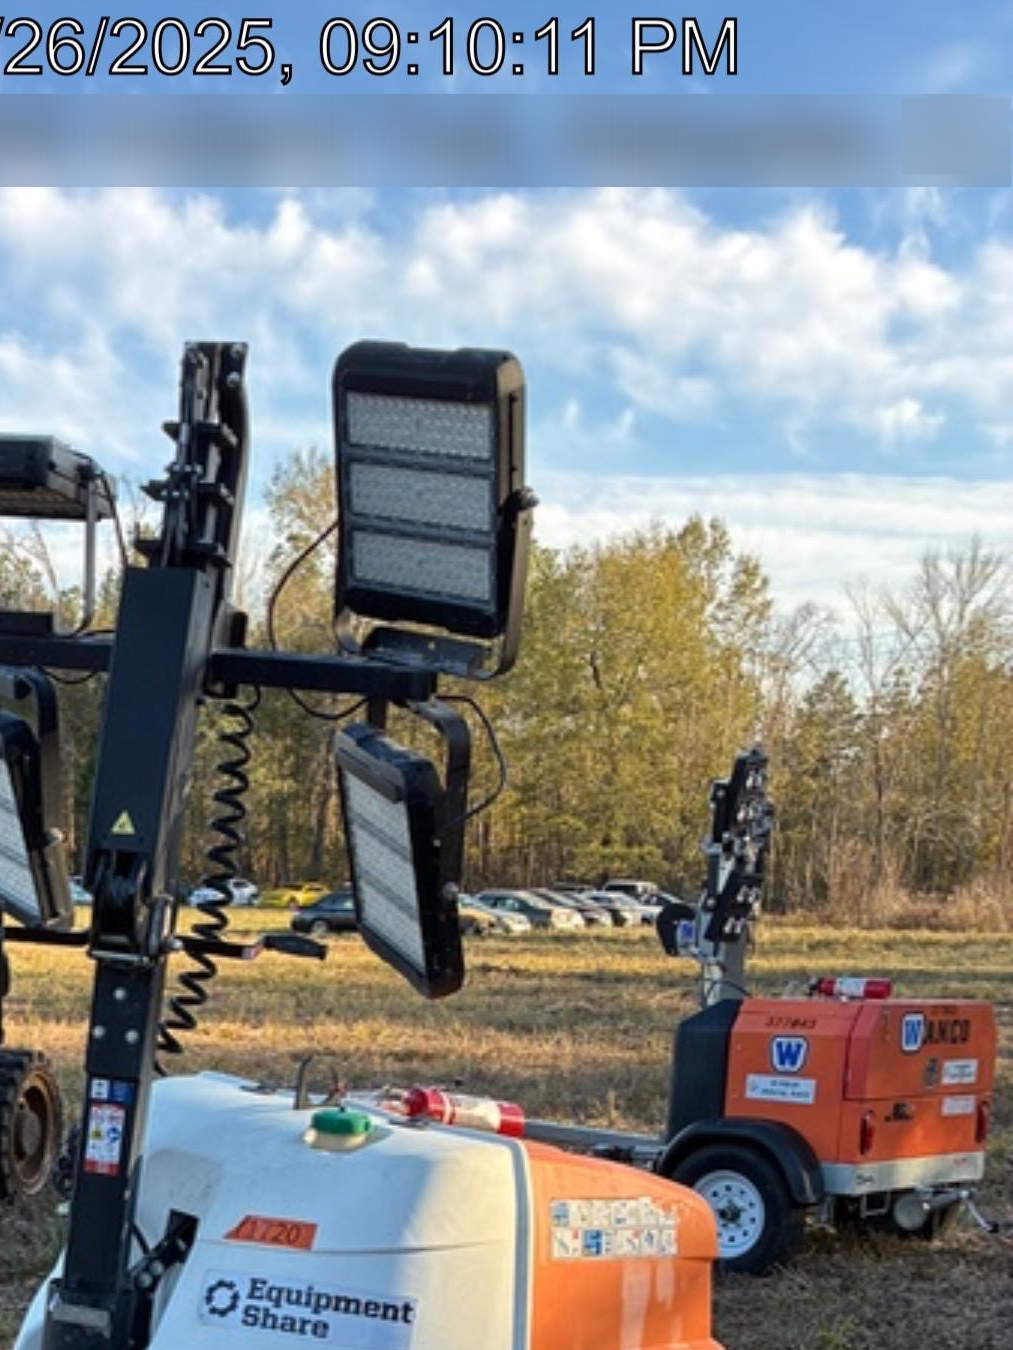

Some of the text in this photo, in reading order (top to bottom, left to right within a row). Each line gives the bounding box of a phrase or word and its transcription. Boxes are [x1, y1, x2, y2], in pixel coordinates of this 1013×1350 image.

[774, 1038, 805, 1068] W
[247, 1277, 415, 1324] Equipment
[241, 1304, 330, 1338] Share
